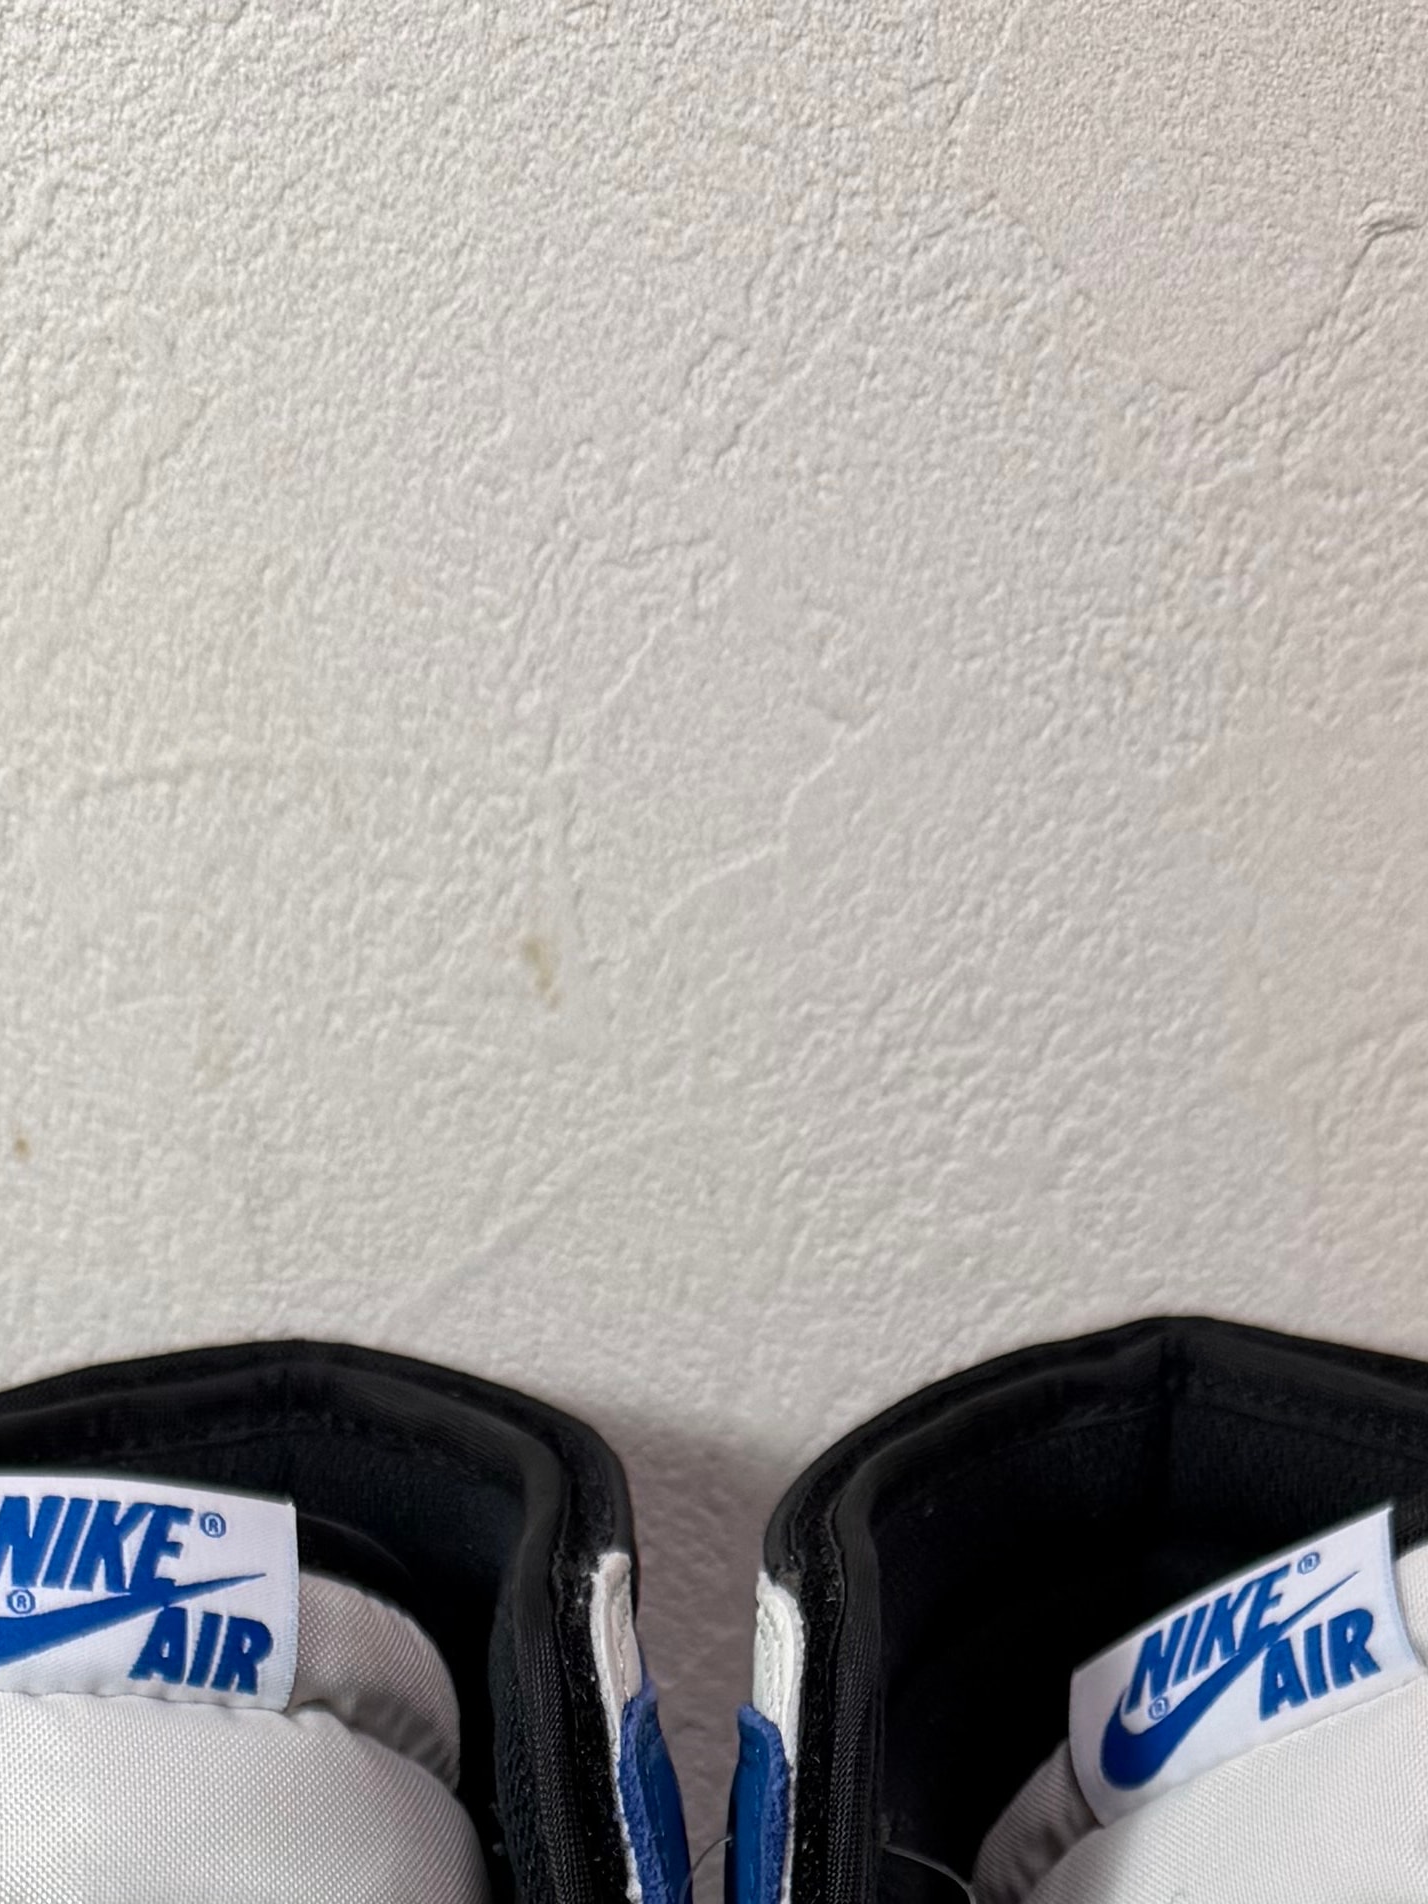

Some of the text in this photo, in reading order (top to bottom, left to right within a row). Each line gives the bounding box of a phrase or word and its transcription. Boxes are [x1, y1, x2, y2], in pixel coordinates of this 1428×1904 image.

[129, 1606, 273, 1695] AIR
[1124, 1563, 1291, 1716] NIKE
[1258, 1608, 1381, 1722] AIR
